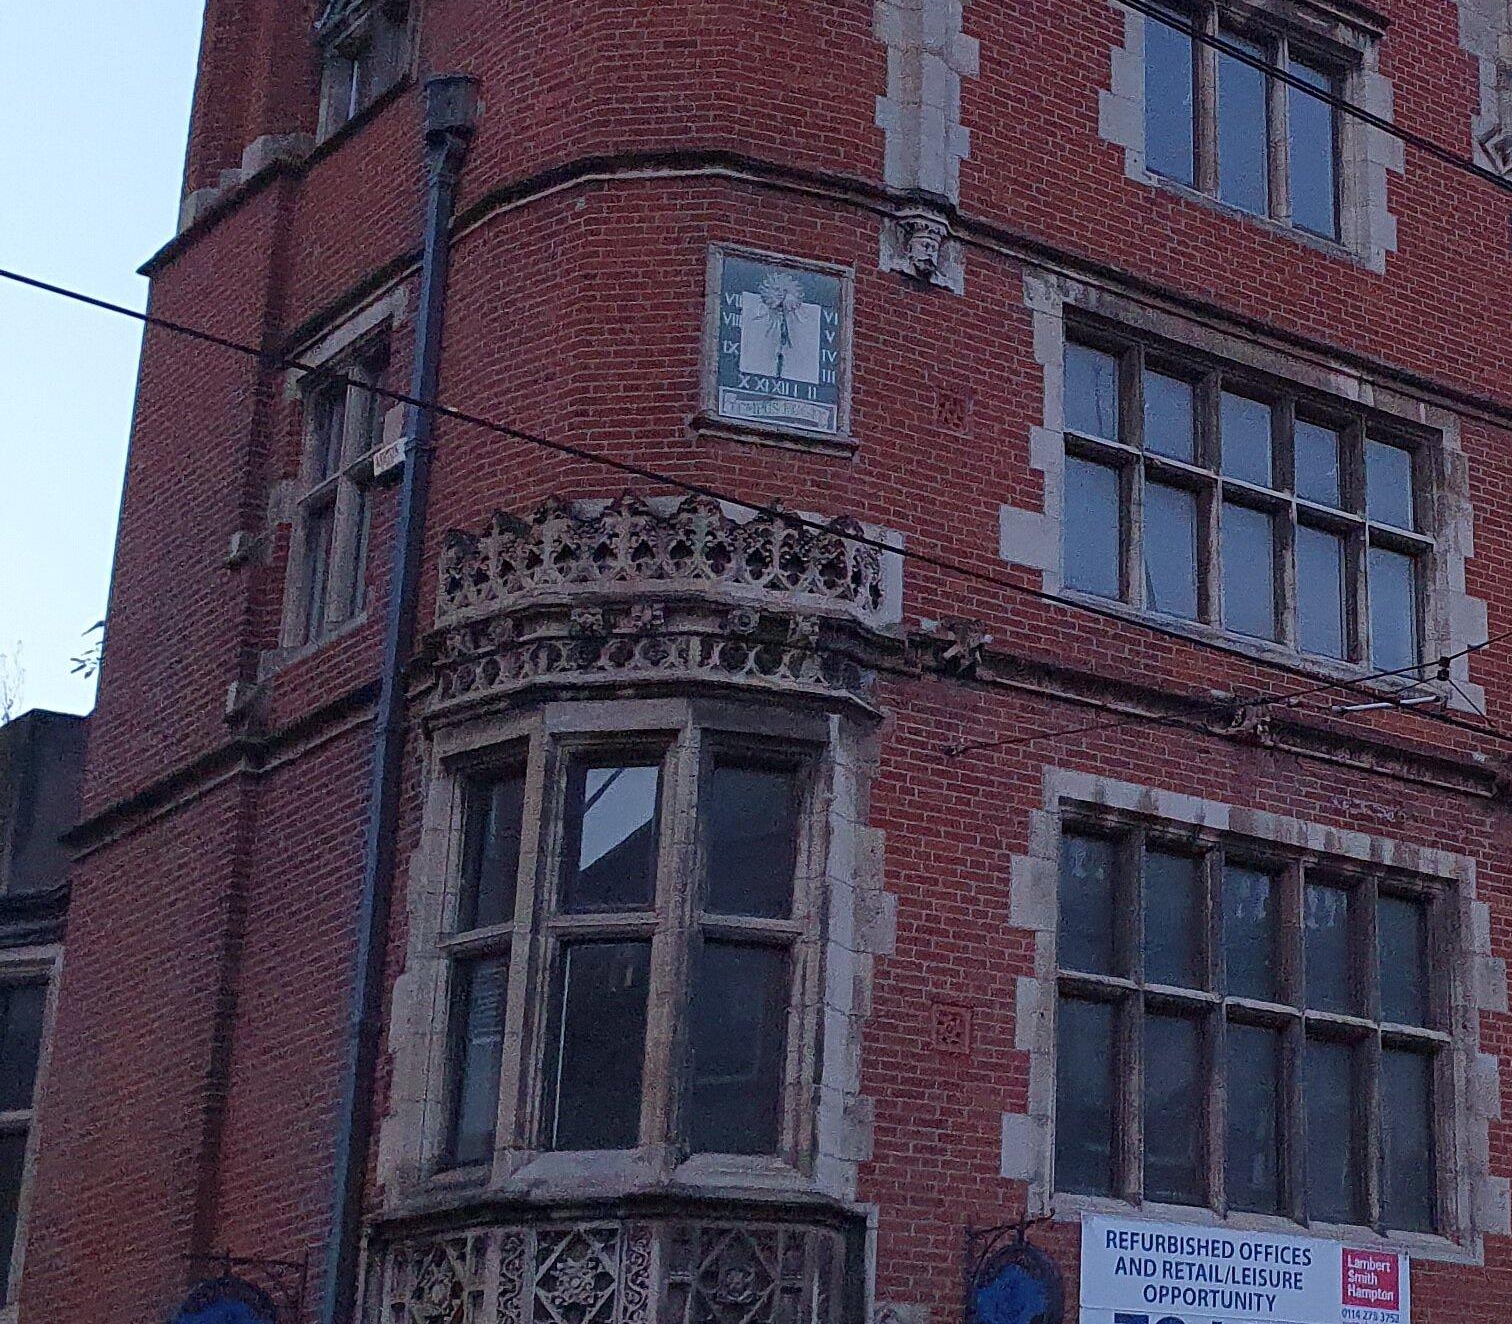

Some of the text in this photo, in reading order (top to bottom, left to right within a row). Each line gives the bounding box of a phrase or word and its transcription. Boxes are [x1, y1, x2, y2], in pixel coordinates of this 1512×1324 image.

[823, 311, 838, 326] VI
[825, 330, 836, 344] V
[723, 341, 740, 355] IX
[822, 349, 837, 363] IV
[822, 369, 836, 384] III
[738, 377, 750, 389] X
[755, 378, 769, 393] XI
[773, 380, 789, 395] XII
[808, 386, 817, 400] II
[1105, 1229, 1312, 1267] REFURBISHED OFFICES
[1347, 1254, 1391, 1273] Lambert
[1114, 1256, 1304, 1291] AND RETAIL/LEISURE
[1347, 1269, 1378, 1286] Smith
[1143, 1284, 1277, 1313] OPPORTUNITY
[1347, 1283, 1394, 1303] Hampton
[1341, 1308, 1360, 1320] 0114
